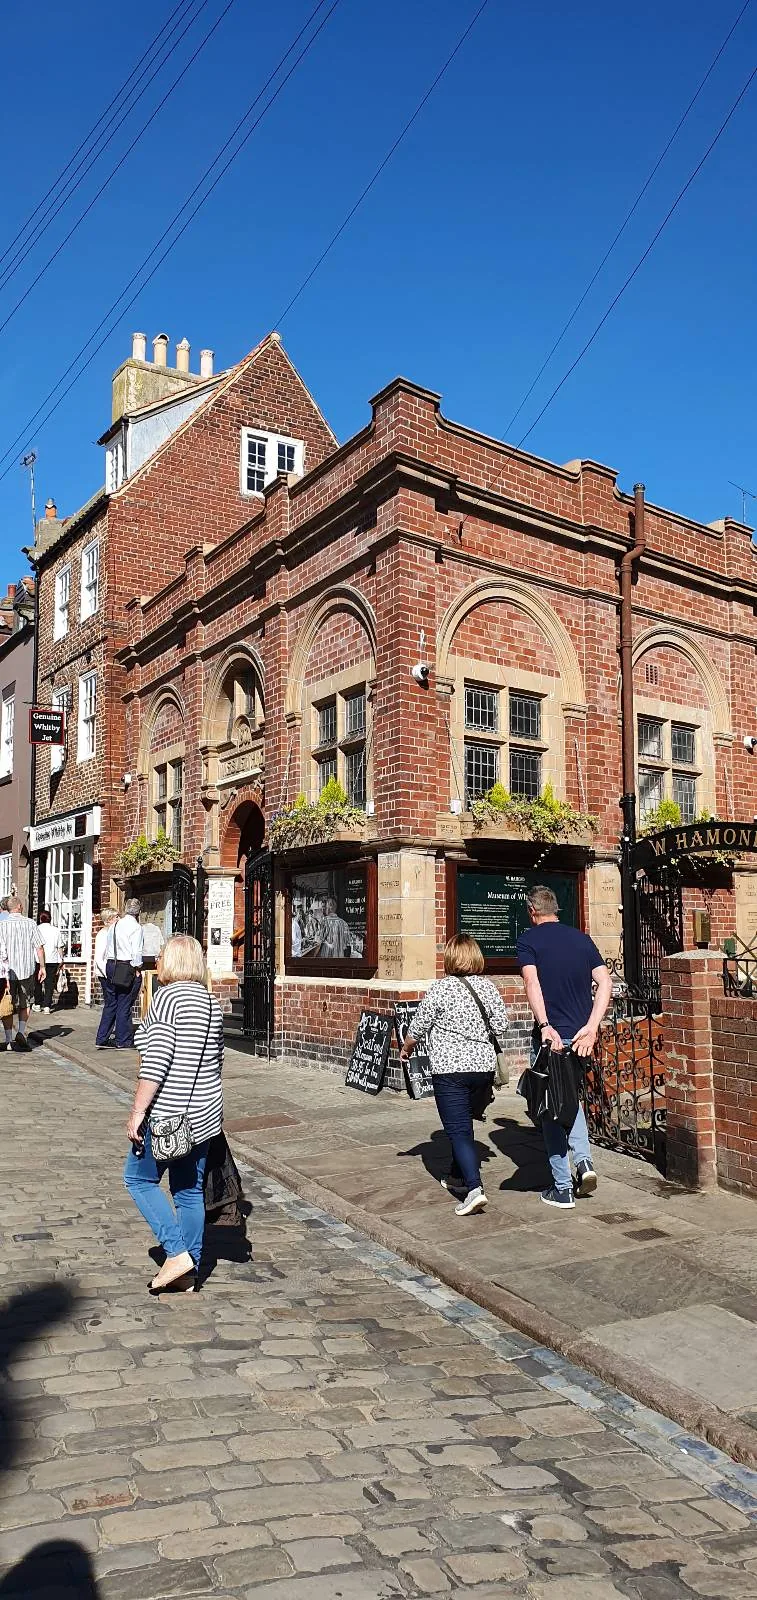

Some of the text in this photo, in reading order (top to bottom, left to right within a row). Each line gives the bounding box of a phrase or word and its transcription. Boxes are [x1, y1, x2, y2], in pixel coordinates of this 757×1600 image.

[33, 713, 62, 721] Genuine
[34, 723, 61, 733] Whitby
[675, 828, 757, 850] HAMON
[487, 891, 510, 900] Museum
[510, 892, 517, 900] of
[210, 900, 232, 910] FREE
